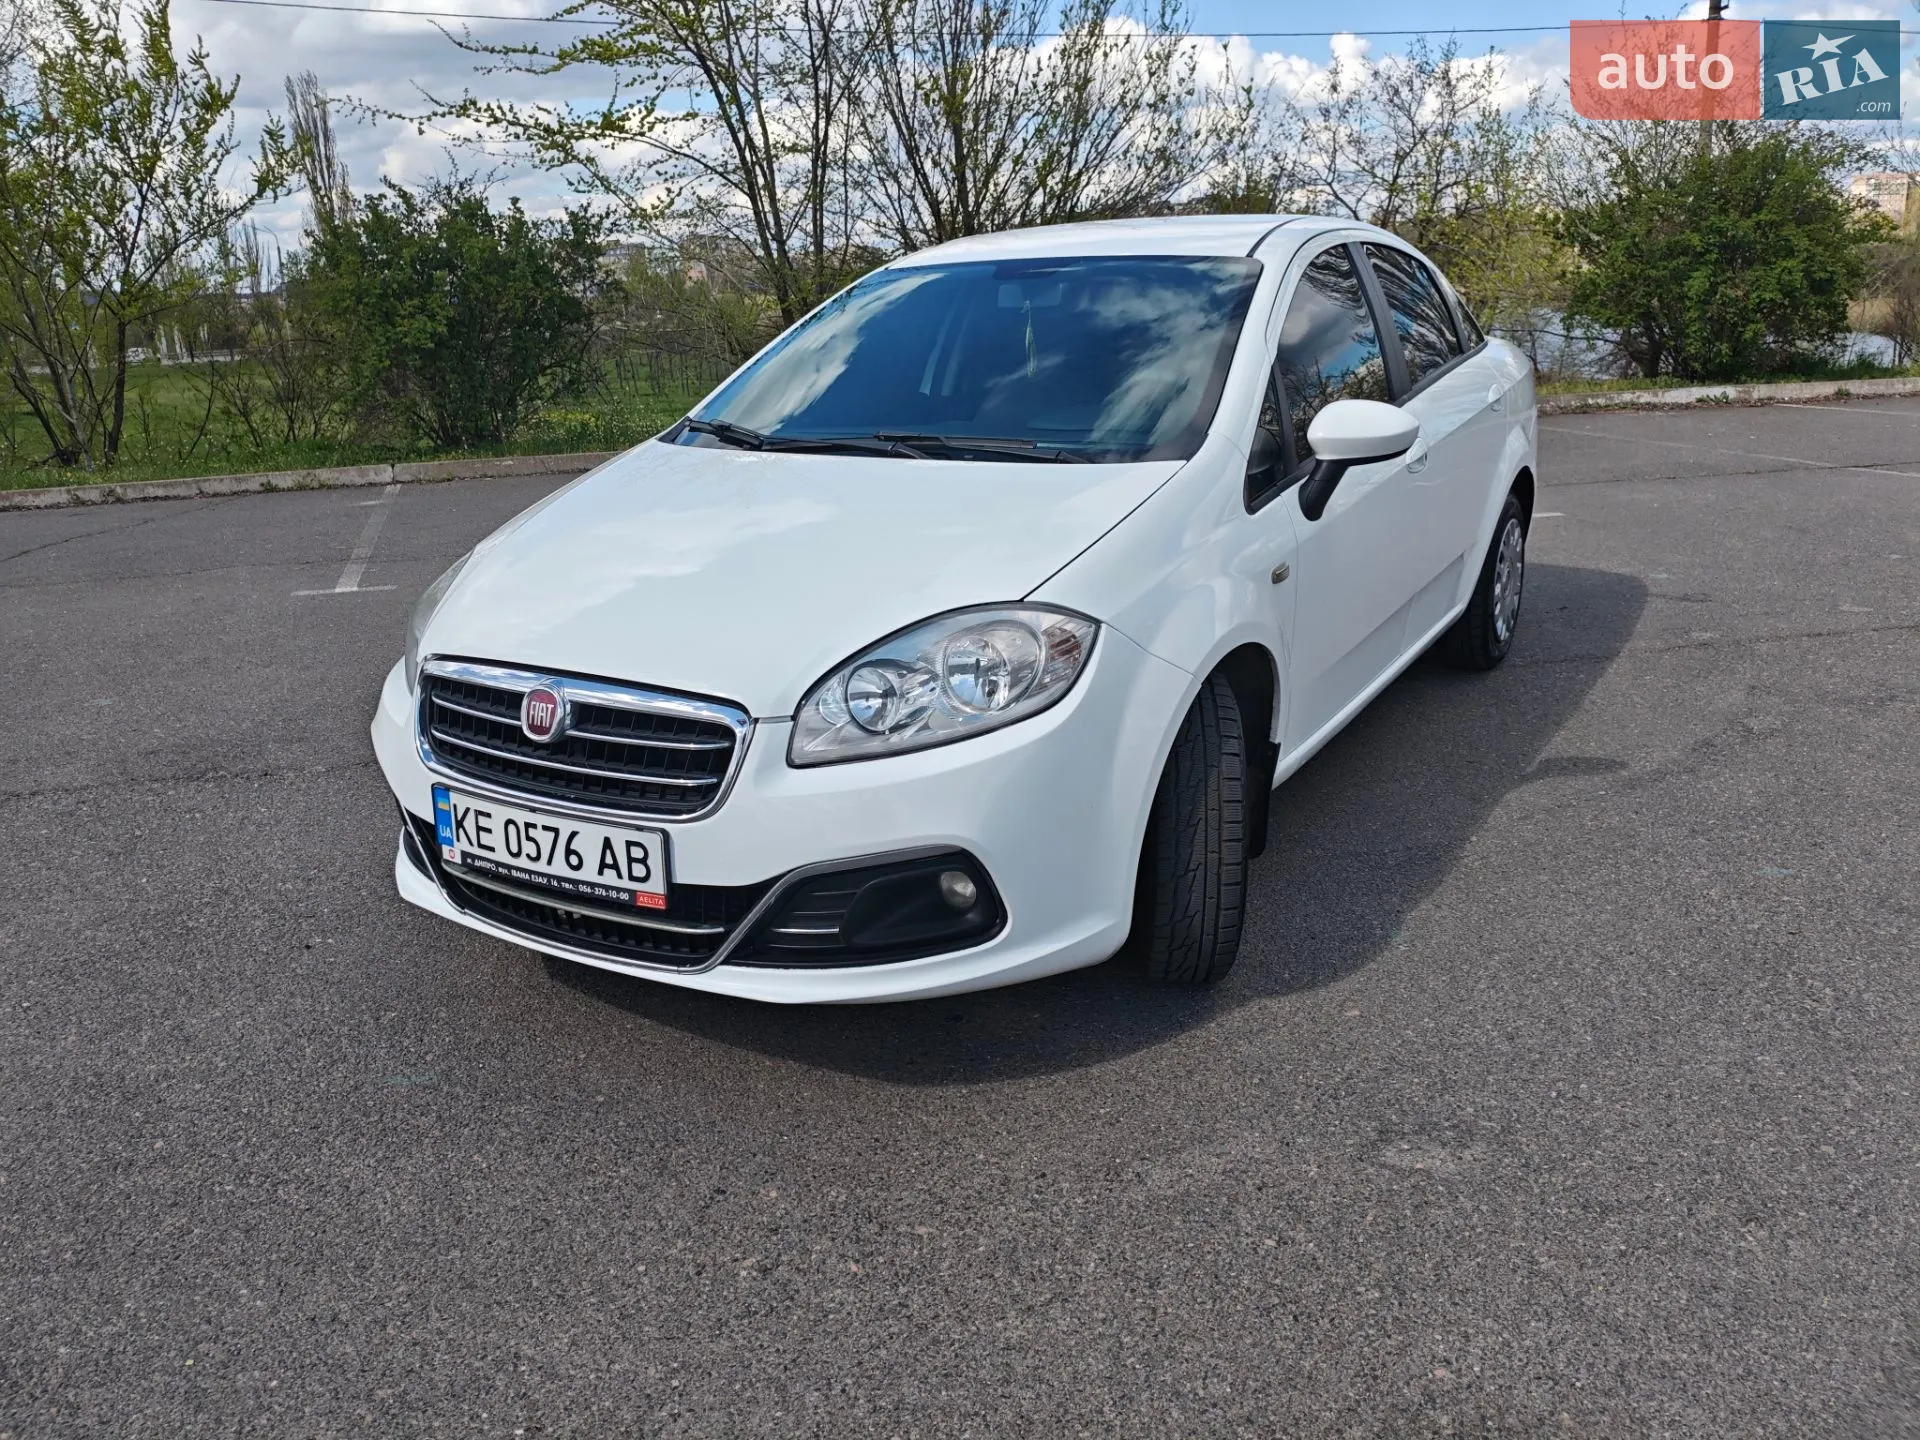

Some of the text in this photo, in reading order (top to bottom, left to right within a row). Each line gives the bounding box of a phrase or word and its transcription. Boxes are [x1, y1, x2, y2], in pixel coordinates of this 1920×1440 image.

[529, 701, 554, 728] FIAT
[439, 824, 452, 839] UA
[453, 803, 652, 883] KE 0576 AB
[578, 884, 630, 900] 056-376-10-00
[639, 896, 664, 905] AELITA
